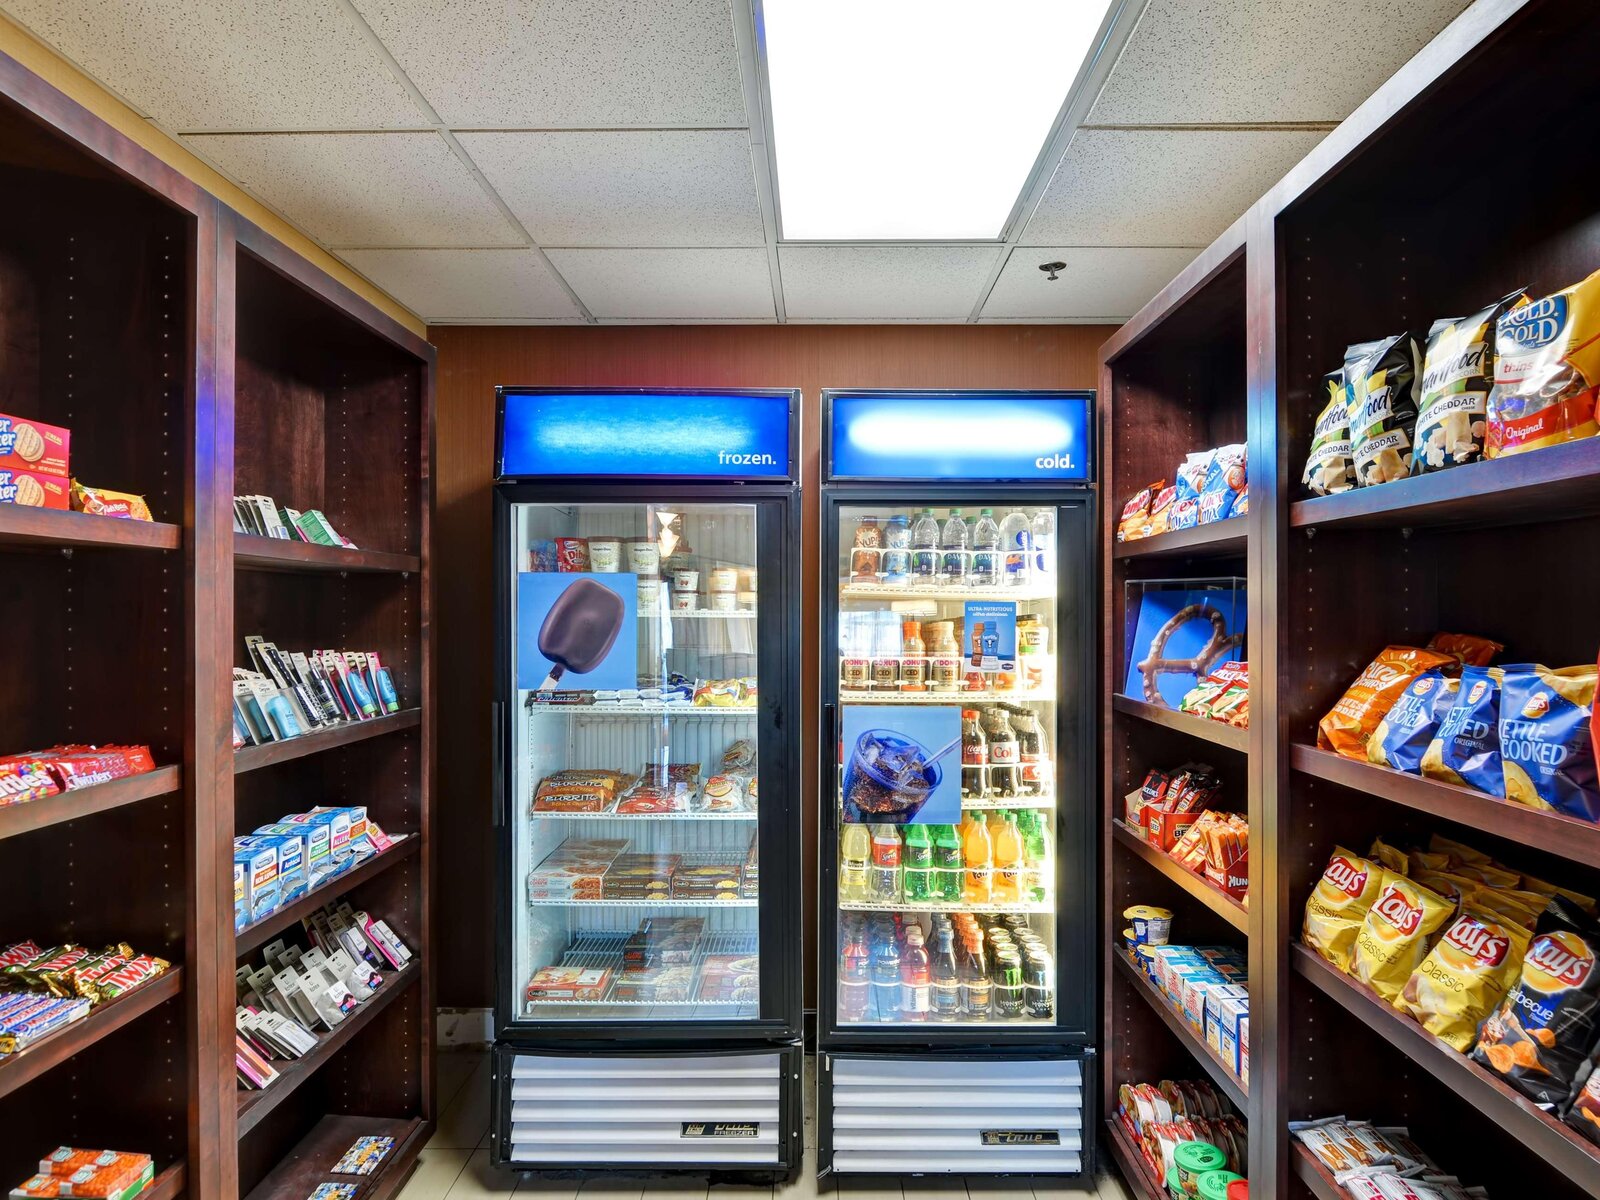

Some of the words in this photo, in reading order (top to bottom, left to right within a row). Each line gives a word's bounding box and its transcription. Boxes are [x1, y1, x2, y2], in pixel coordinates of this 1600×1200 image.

[1433, 397, 1476, 416] CHEDDAR
[1505, 417, 1544, 440] Original
[1318, 444, 1349, 456] CHEDDAR
[1363, 435, 1398, 454] CHEDDAR
[718, 450, 777, 465] frozen.
[1035, 453, 1075, 469] cold.
[1386, 706, 1421, 728] OOKED
[1453, 737, 1486, 751] ORIGINAL
[1501, 739, 1568, 766] COOKED
[1228, 874, 1248, 888] MUN
[1307, 895, 1343, 922] Classic
[1359, 931, 1387, 963] Classic
[1442, 914, 1507, 960] Lay's
[1524, 937, 1590, 980] Lay's
[98, 954, 158, 990] TWIX
[1421, 960, 1465, 993] Classic
